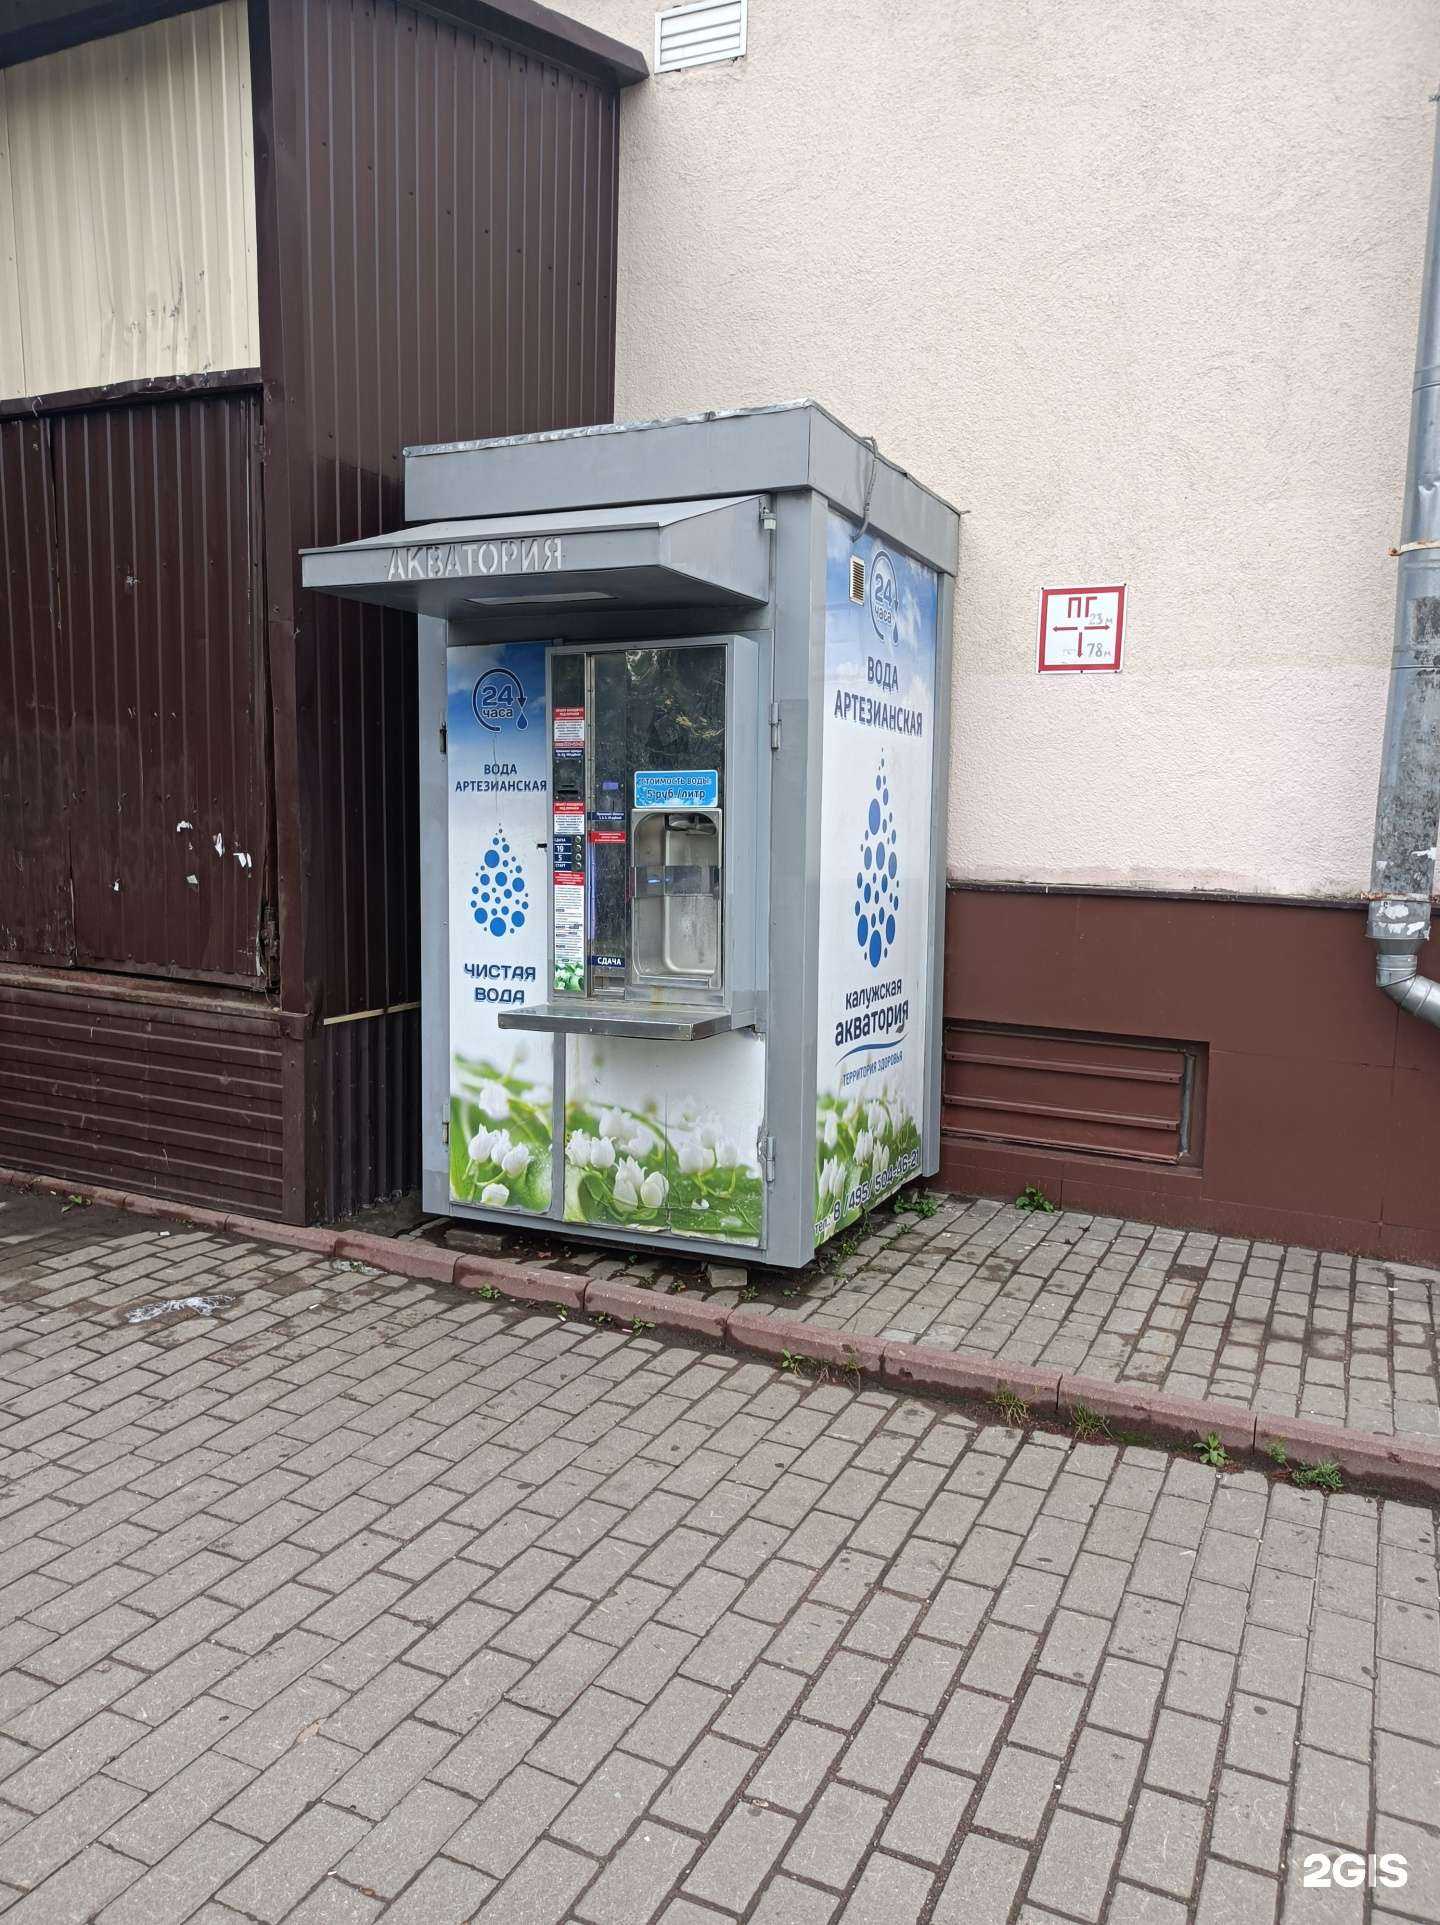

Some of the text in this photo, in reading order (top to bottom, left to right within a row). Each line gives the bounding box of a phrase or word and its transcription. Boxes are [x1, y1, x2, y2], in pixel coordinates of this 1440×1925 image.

[388, 536, 562, 580] АКВАТОРИЯ
[875, 573, 893, 607] 24
[874, 606, 892, 624] часа
[1067, 595, 1098, 618] ПГ
[1089, 612, 1103, 625] 23
[1087, 642, 1103, 658] 78
[867, 656, 899, 691] ВОДА
[481, 684, 515, 707] 24
[481, 708, 514, 719] часа
[834, 689, 923, 737] АРТЕЗИАНСКАЯ
[483, 763, 518, 776] ВОДА
[455, 780, 547, 793] АРТЕЗИАНСКАЯ
[647, 789, 653, 799] 5
[597, 956, 622, 966] СДАЧА
[463, 963, 536, 981] ЧИСТАЯ
[474, 986, 525, 1004] ВОДА
[845, 978, 903, 1010] калужская
[834, 999, 909, 1046] акватория
[842, 1050, 903, 1087] ТЕРРИТОРИЯ ЗДОРОВЬЯ
[833, 1201, 842, 1222] 8
